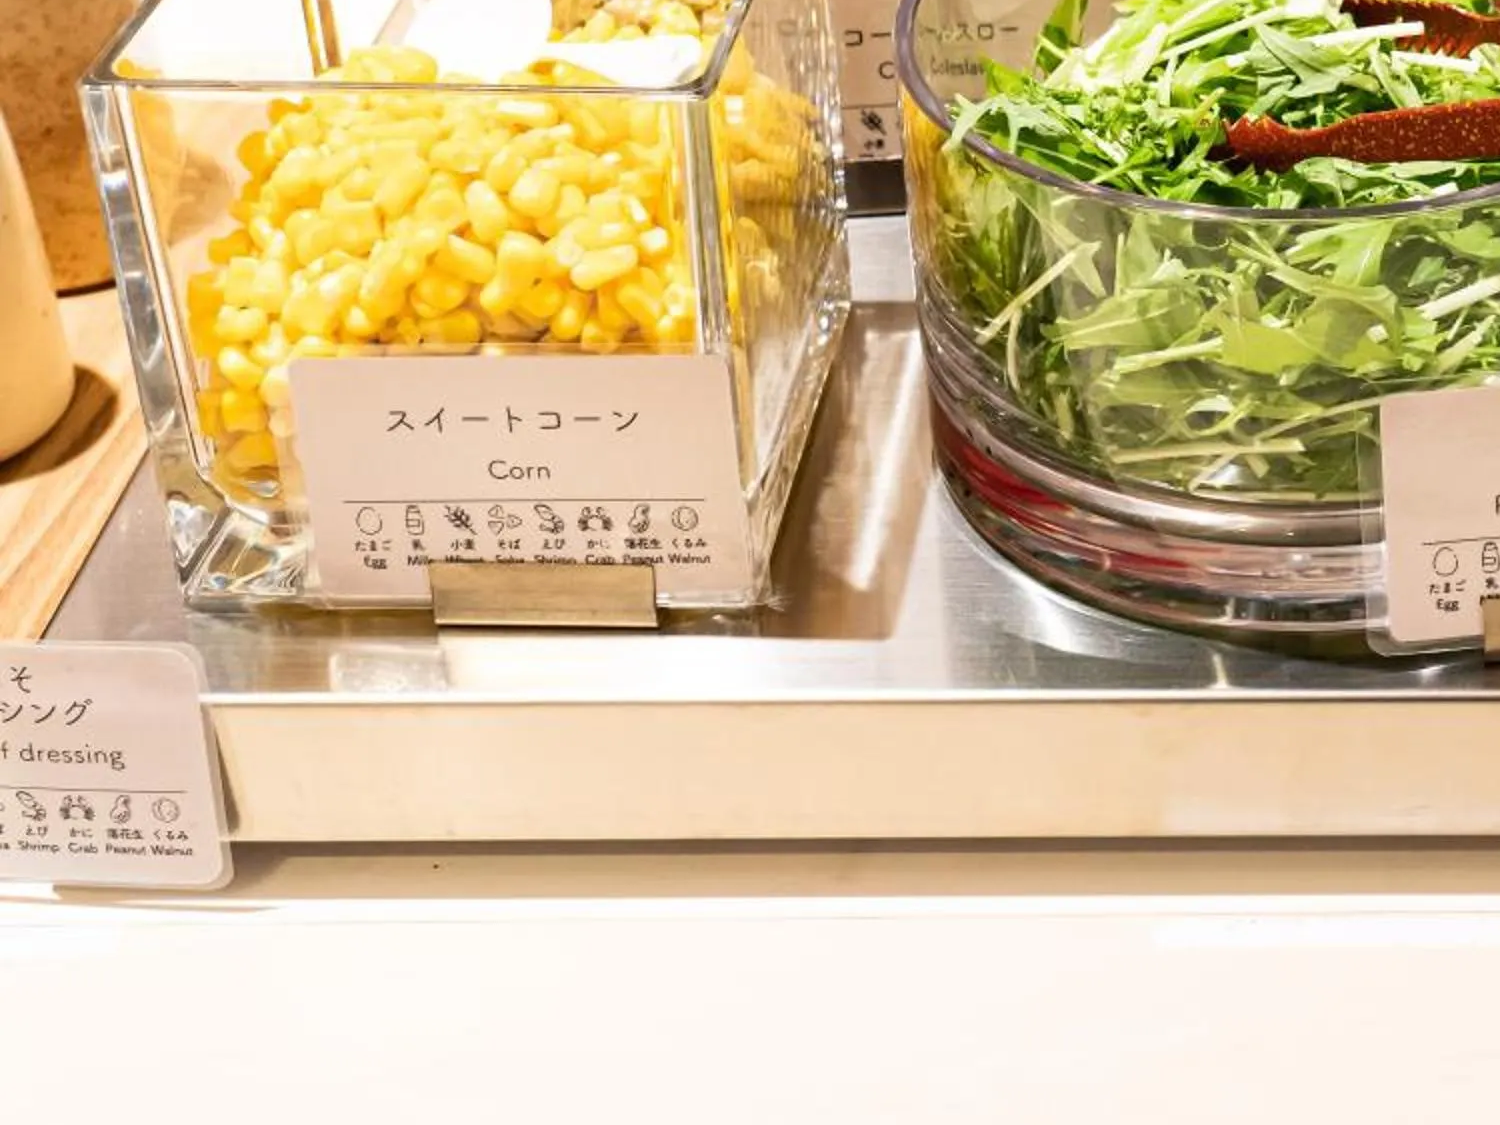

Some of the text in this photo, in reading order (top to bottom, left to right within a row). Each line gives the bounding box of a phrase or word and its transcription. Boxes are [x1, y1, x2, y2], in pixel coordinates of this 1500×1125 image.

[386, 406, 639, 434] スイートコーン
[488, 459, 552, 480] Corn
[363, 555, 388, 570] Egg
[667, 554, 712, 565] Walnut
[1436, 598, 1460, 612] Egg
[19, 742, 127, 771] dressing
